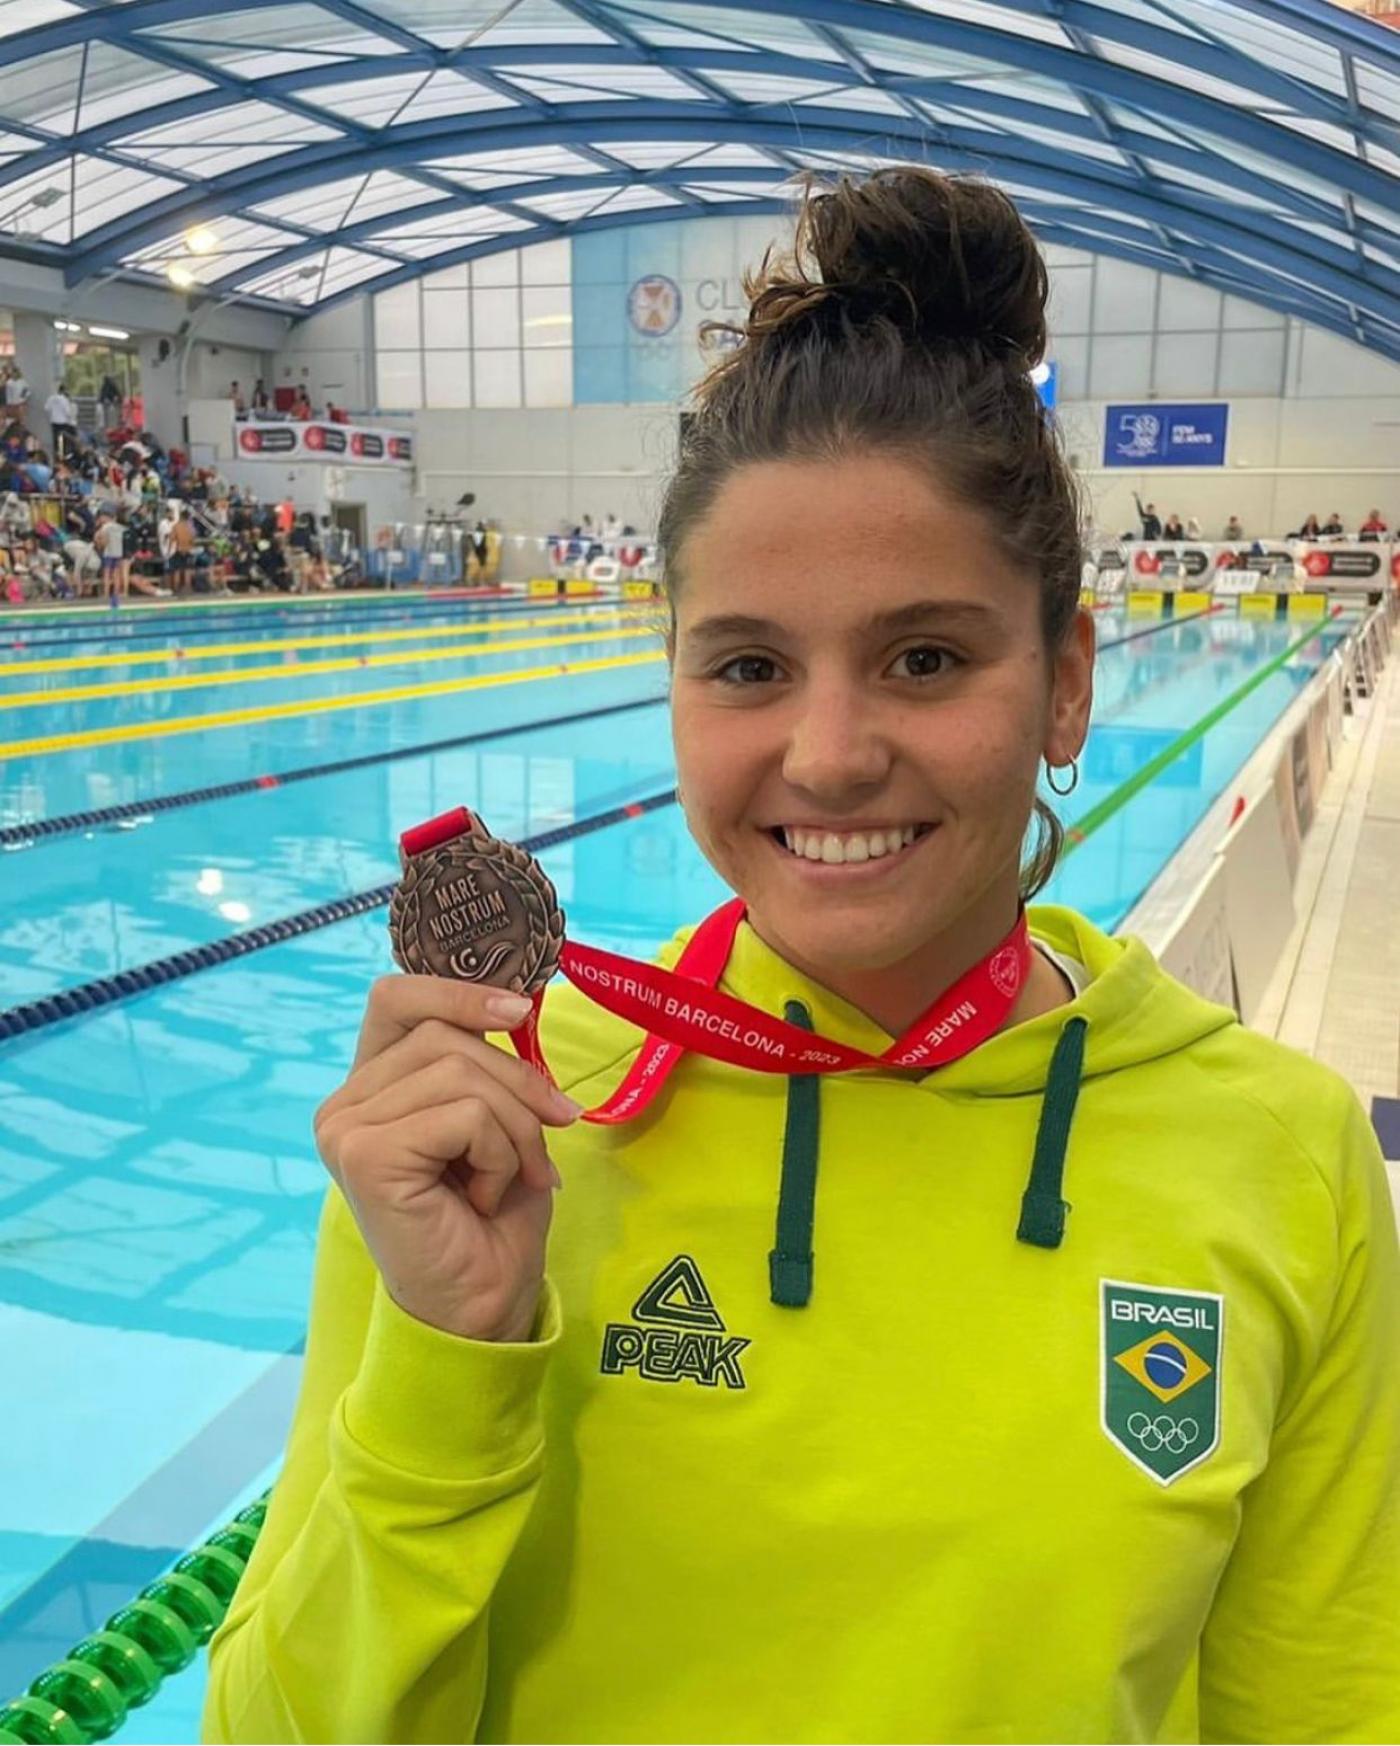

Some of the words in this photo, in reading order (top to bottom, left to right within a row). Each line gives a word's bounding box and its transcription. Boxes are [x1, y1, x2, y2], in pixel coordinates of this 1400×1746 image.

[696, 279, 745, 311] CL
[435, 873, 480, 910] MARE
[429, 890, 506, 941] NOSTRUM
[439, 915, 511, 953] BARCELONA
[569, 958, 662, 1009] NOSTRUM
[664, 996, 786, 1059] BARCELONA
[798, 1048, 842, 1065] 2023
[924, 1001, 979, 1048] MARE
[1110, 1298, 1215, 1331] BRASIL
[600, 1323, 752, 1389] PEAK
